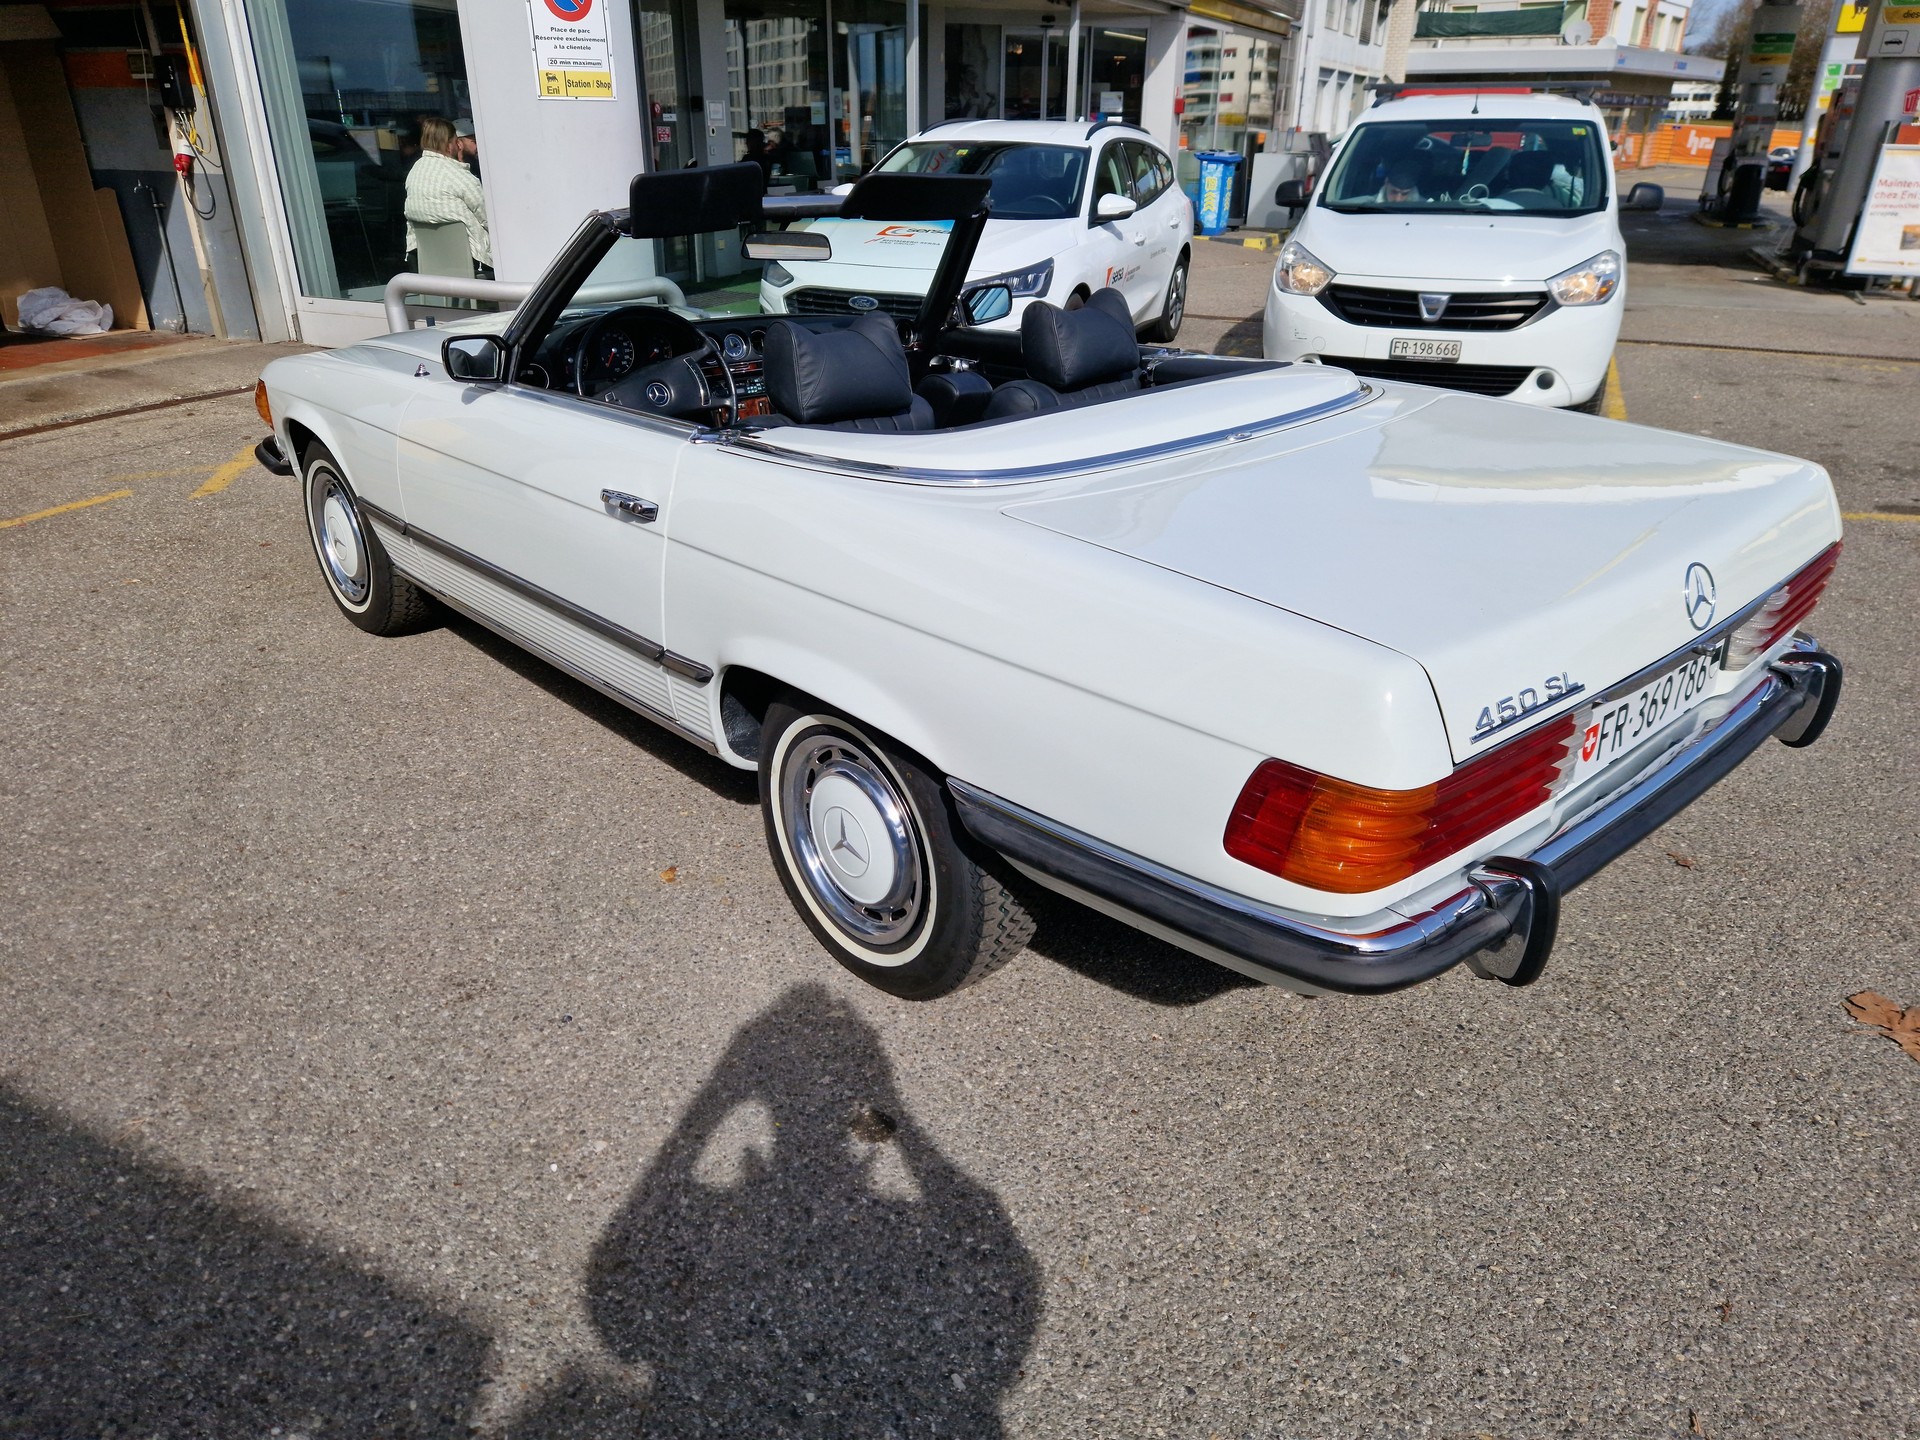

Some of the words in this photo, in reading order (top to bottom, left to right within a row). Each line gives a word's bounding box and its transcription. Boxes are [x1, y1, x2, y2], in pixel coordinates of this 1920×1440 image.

[547, 86, 560, 95] Eni
[567, 78, 592, 89] Station
[595, 79, 612, 91] Shop
[1475, 687, 1538, 732] 450
[1543, 671, 1580, 699] SL
